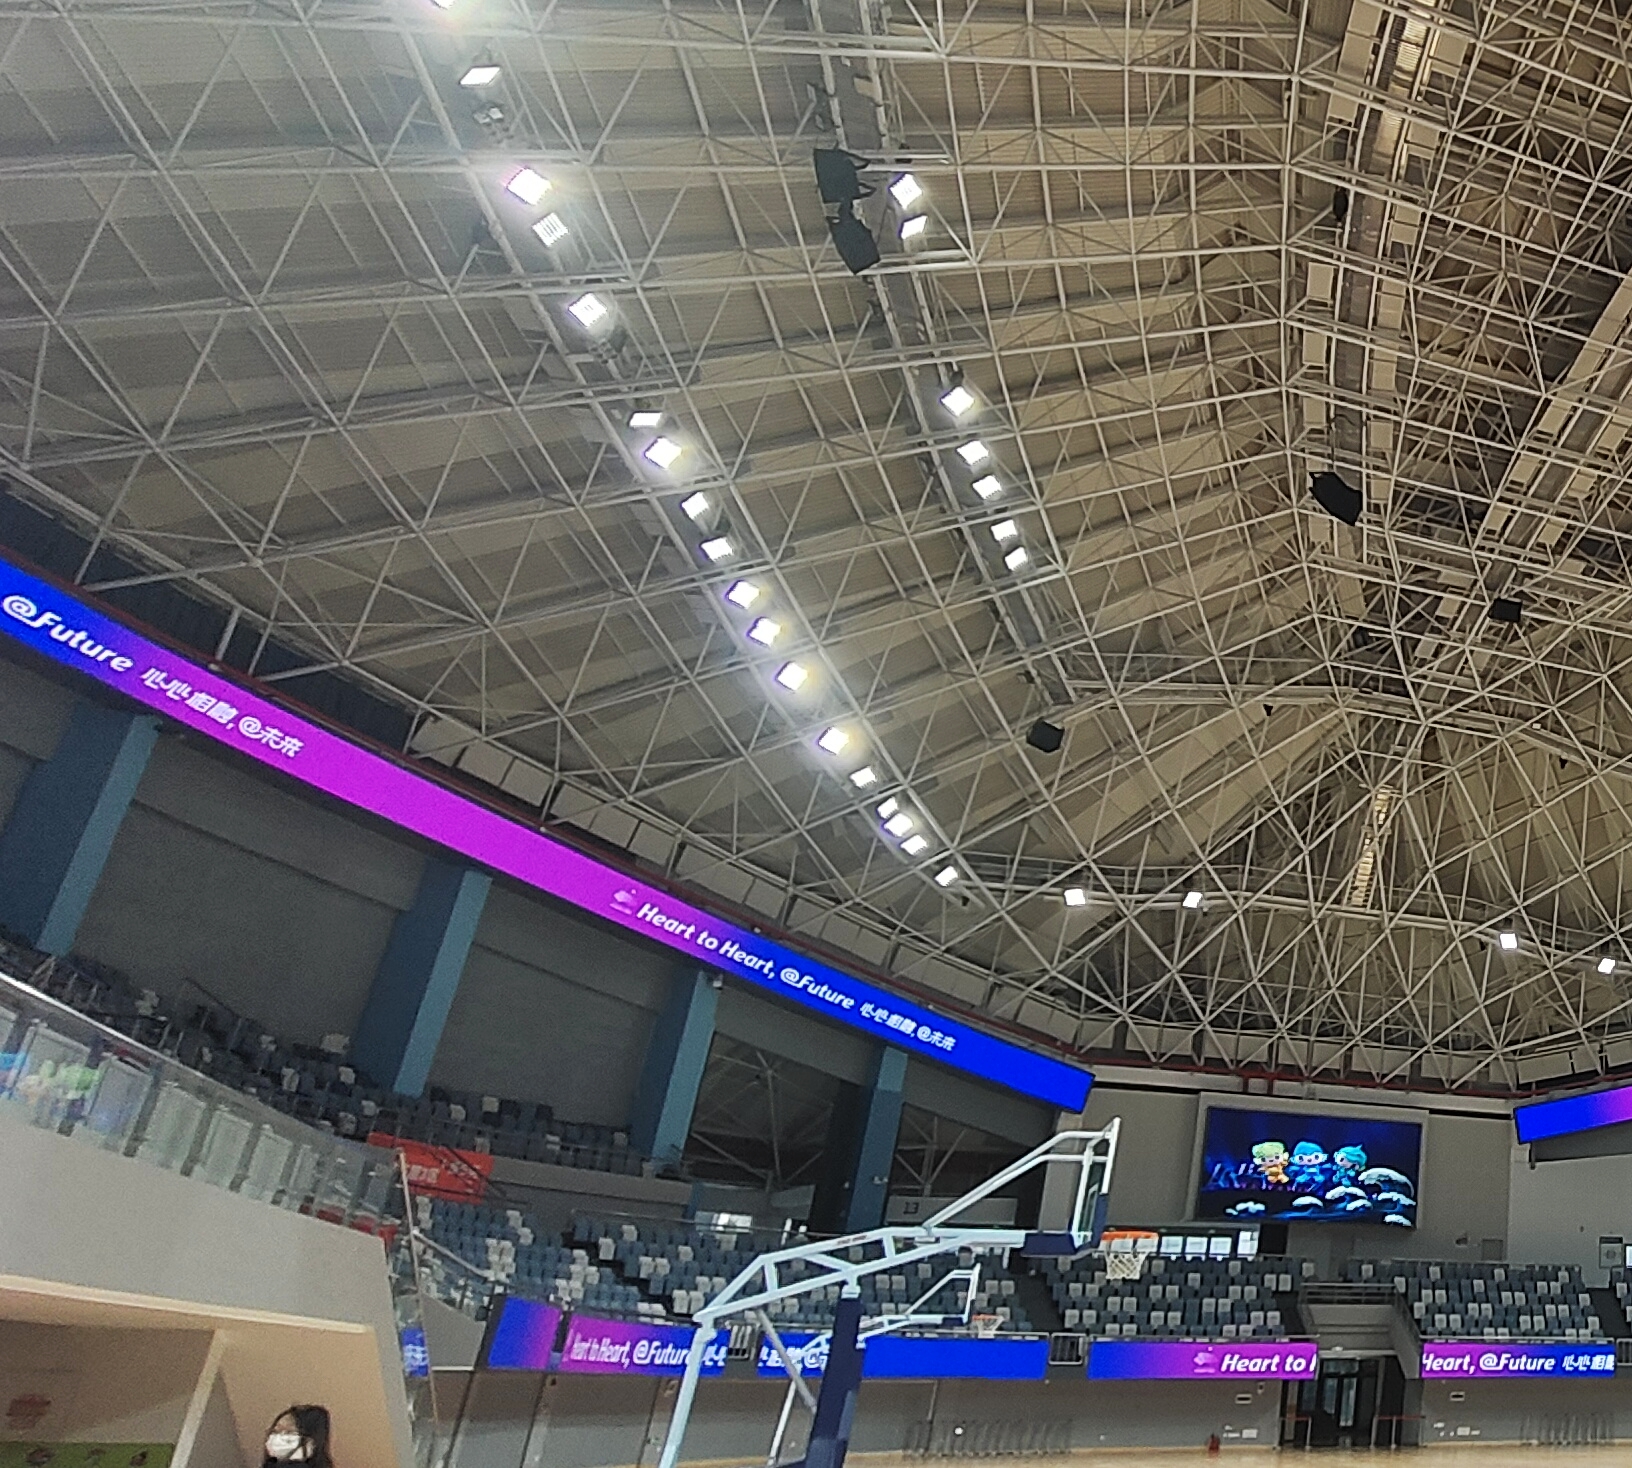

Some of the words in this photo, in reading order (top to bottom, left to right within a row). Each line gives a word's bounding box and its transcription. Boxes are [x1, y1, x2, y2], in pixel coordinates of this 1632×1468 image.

[3, 595, 134, 671] @Future
[636, 903, 695, 940] Heart
[696, 931, 718, 950] to
[719, 941, 775, 979] Heart,
[780, 967, 855, 1009] @Future
[1221, 1353, 1280, 1372] Heart
[1284, 1354, 1306, 1373] to
[1479, 1353, 1556, 1371] @Future
